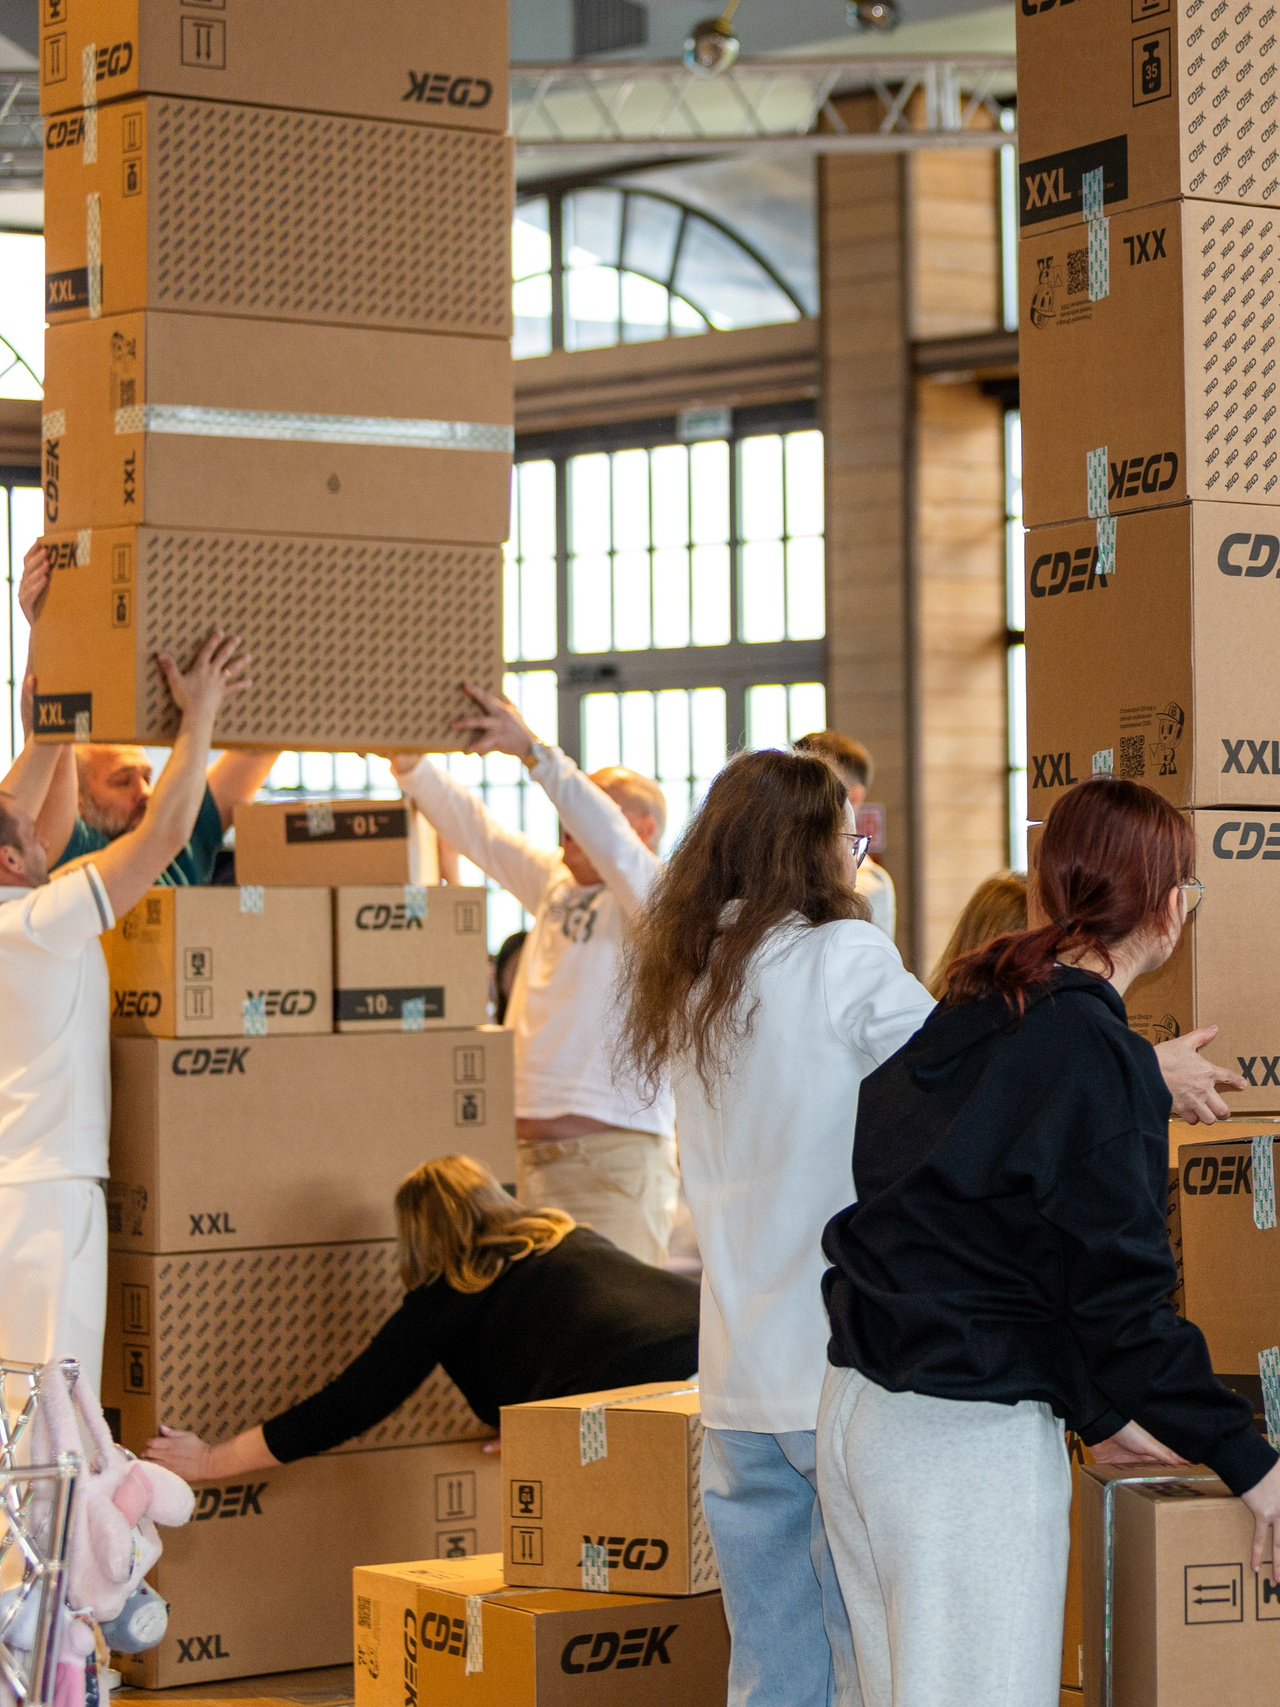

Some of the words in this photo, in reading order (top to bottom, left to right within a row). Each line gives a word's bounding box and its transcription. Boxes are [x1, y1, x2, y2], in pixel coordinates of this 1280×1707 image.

[1235, 2, 1252, 25] CDEK
[1236, 31, 1253, 53] CDEK
[95, 42, 133, 82] CDE
[1145, 63, 1158, 80] 35
[402, 69, 494, 110] CDEK
[1237, 88, 1254, 111] CDEK
[1237, 117, 1254, 140] CDEK
[1189, 140, 1206, 163] CDEK
[1238, 146, 1255, 168] CDEK
[1025, 167, 1072, 211] XXL
[1201, 215, 1215, 234] CDEK
[1123, 227, 1168, 266] XXL
[49, 279, 76, 304] XXL
[1241, 312, 1255, 330] CDEK
[1222, 333, 1237, 352] CDEK
[1263, 452, 1277, 470] CDEK
[46, 439, 60, 523] CDEK
[124, 449, 136, 505] XXL
[1108, 451, 1179, 500] CDEK
[1244, 474, 1258, 492] CDEK
[47, 541, 79, 570] DEK
[39, 702, 66, 726] XXL
[1032, 752, 1078, 789] XXL
[112, 990, 162, 1018] CDEK
[364, 994, 389, 1015] 10
[172, 1046, 251, 1076] CDEK
[189, 1212, 237, 1236] XXL
[191, 1482, 269, 1522] DEK
[421, 1611, 468, 1658] CDE
[177, 1634, 230, 1664] XXL
[560, 1624, 680, 1675] CDEK
